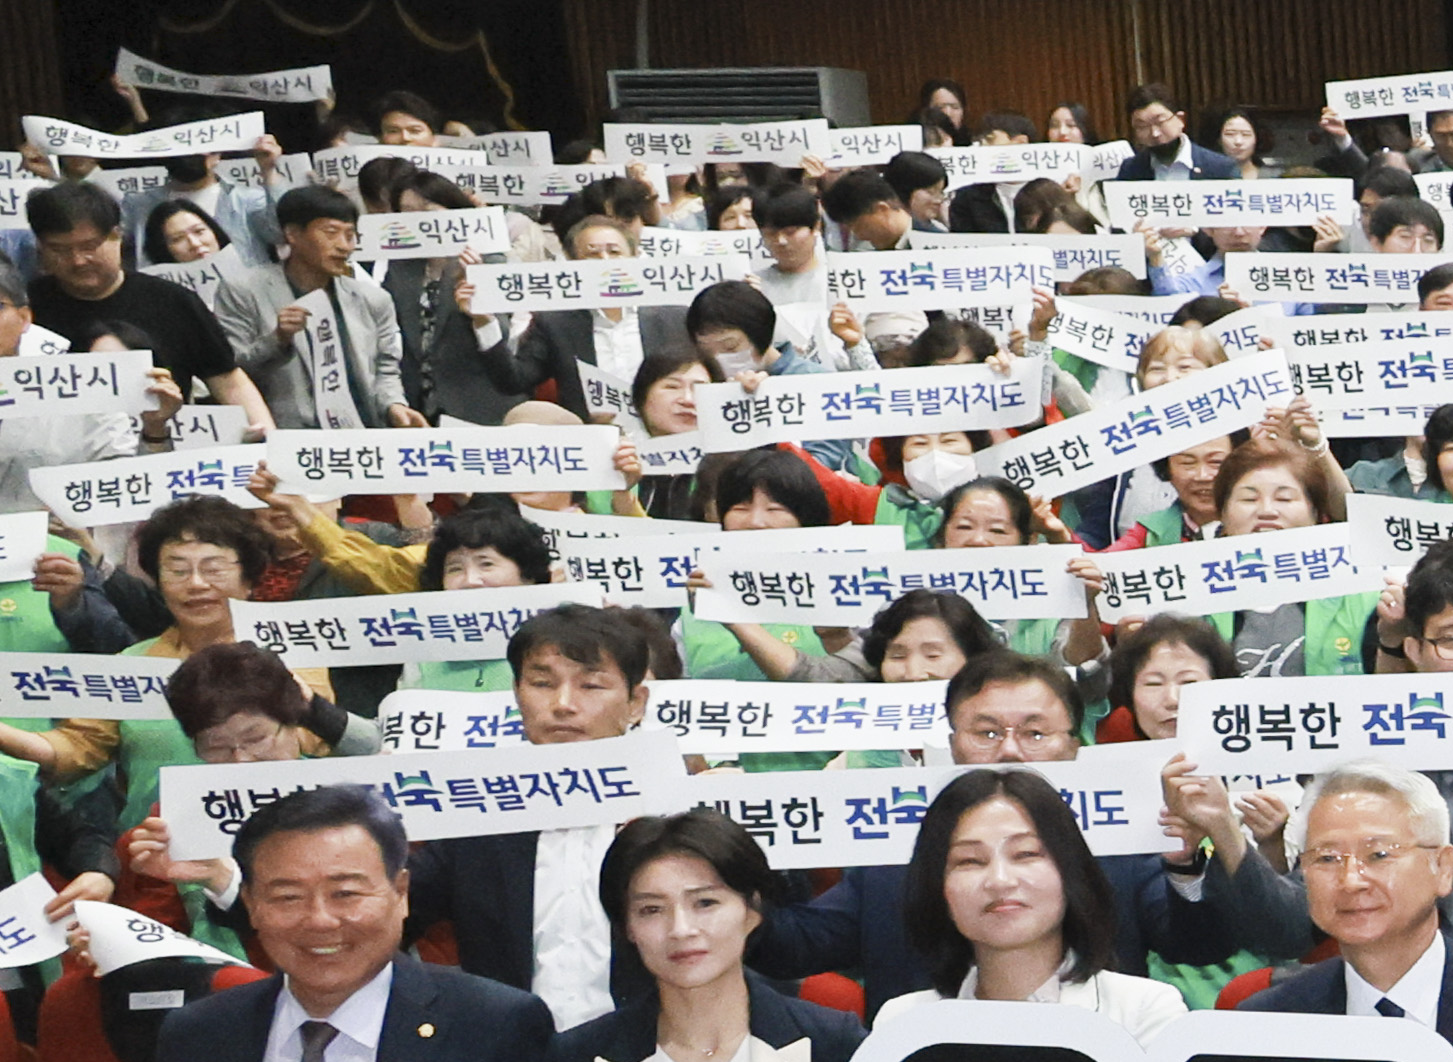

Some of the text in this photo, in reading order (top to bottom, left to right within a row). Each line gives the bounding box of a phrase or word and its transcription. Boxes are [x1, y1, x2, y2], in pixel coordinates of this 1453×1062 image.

[249, 75, 313, 96] 익산시
[1345, 88, 1393, 109] 행복한
[45, 121, 240, 155] 행복한 익산시
[626, 128, 809, 156] 행복한 익산시
[841, 133, 904, 154] 익산시
[1022, 150, 1080, 170] 익산시
[457, 173, 524, 197] 행복한
[1128, 190, 1335, 218] 행복한 전북특별자치도
[419, 216, 493, 244] 익산시
[497, 264, 724, 301] 행복한 익산시
[880, 262, 1054, 295] 전북특별자치도
[1249, 267, 1314, 291] 행복한
[14, 363, 118, 399] 익산시
[721, 382, 1025, 433] 행복한 전북특별자치도
[1002, 370, 1289, 489] 행복한 전북특별자치도
[297, 441, 587, 480] 행복한 전북특별자치도
[65, 473, 151, 512] 행복한
[729, 571, 814, 607] 행복한
[255, 618, 350, 653] 행복한
[657, 700, 772, 737] 행복한
[1212, 702, 1341, 752] 행복한
